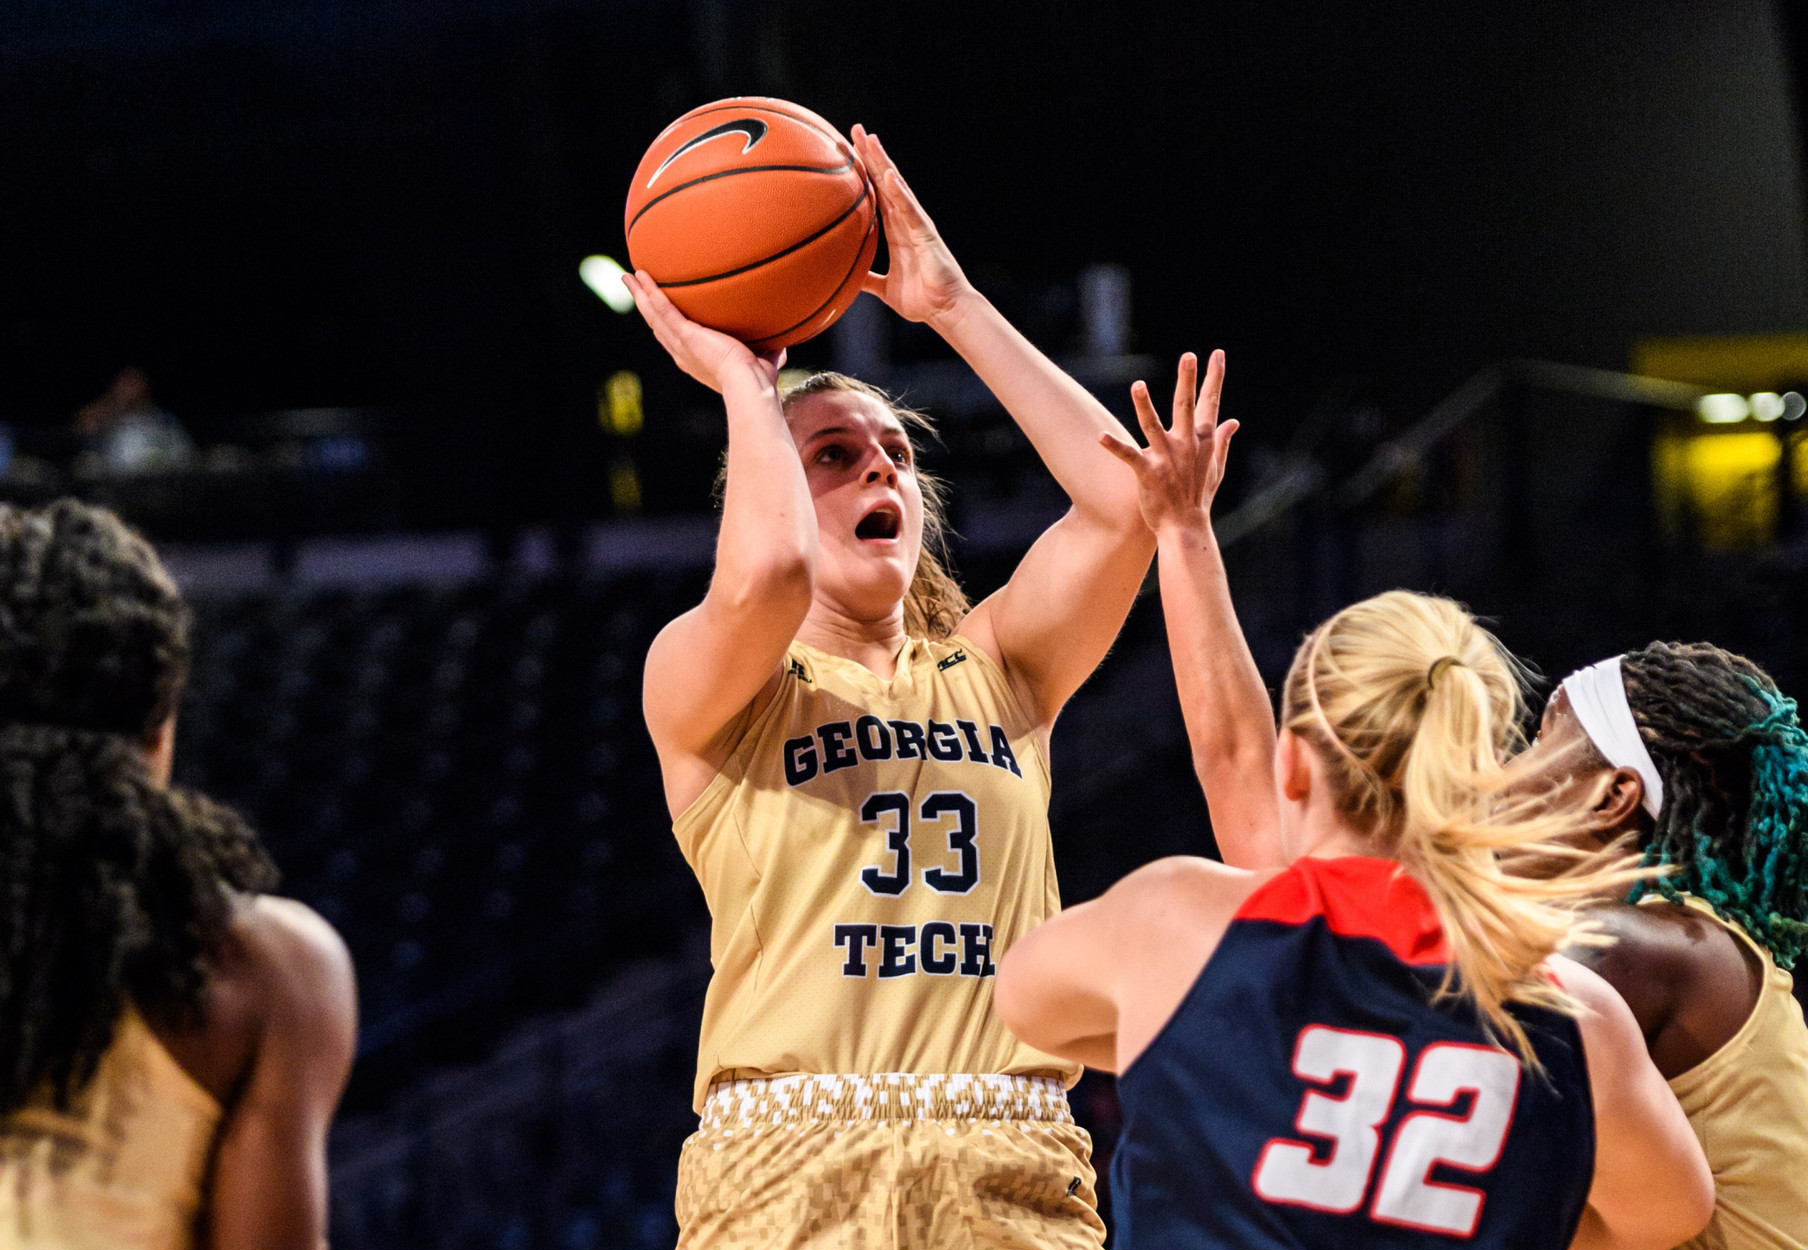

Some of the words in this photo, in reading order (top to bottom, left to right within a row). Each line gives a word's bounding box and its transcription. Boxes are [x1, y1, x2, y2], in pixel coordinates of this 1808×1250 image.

[784, 714, 1024, 787] GEORGIA
[858, 789, 981, 898] 33
[833, 921, 996, 980] TECH
[1251, 1022, 1522, 1241] 32
